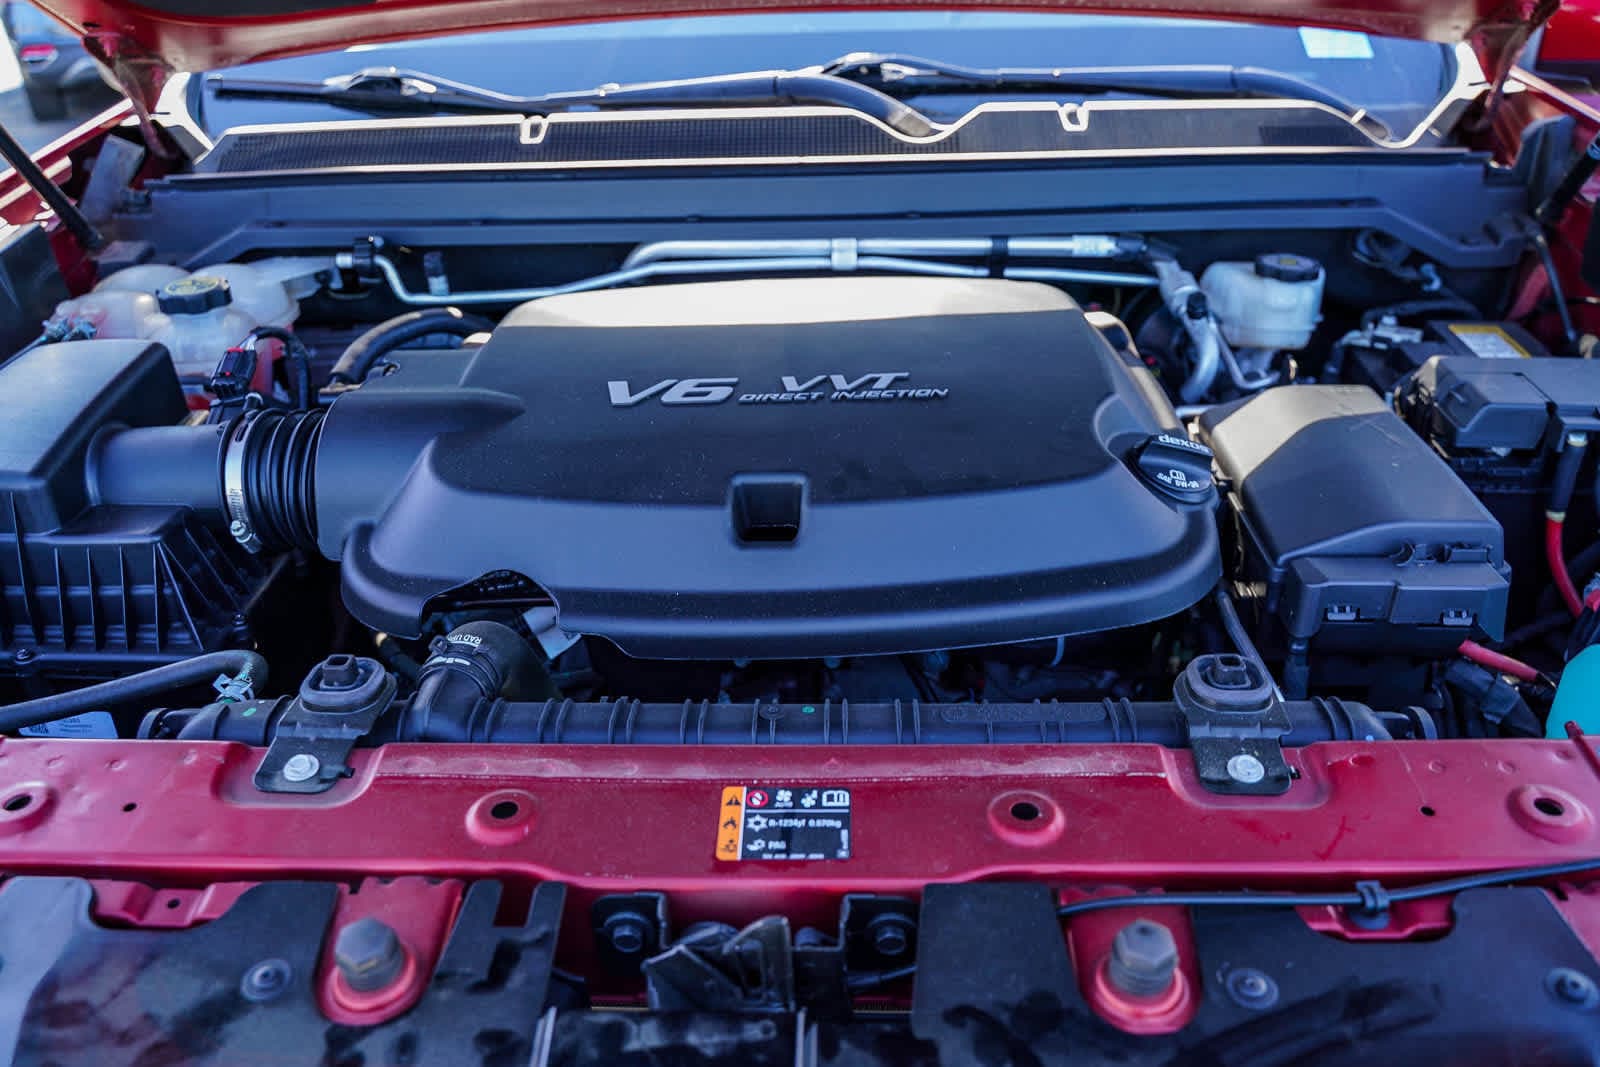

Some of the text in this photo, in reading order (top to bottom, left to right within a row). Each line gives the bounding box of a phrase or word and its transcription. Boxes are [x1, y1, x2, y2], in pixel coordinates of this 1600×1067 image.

[781, 372, 910, 392] VVT
[607, 377, 739, 407] V6
[738, 387, 949, 403] DIRECT INJECTION
[1158, 434, 1210, 453] dexos
[463, 634, 482, 645] RAD
